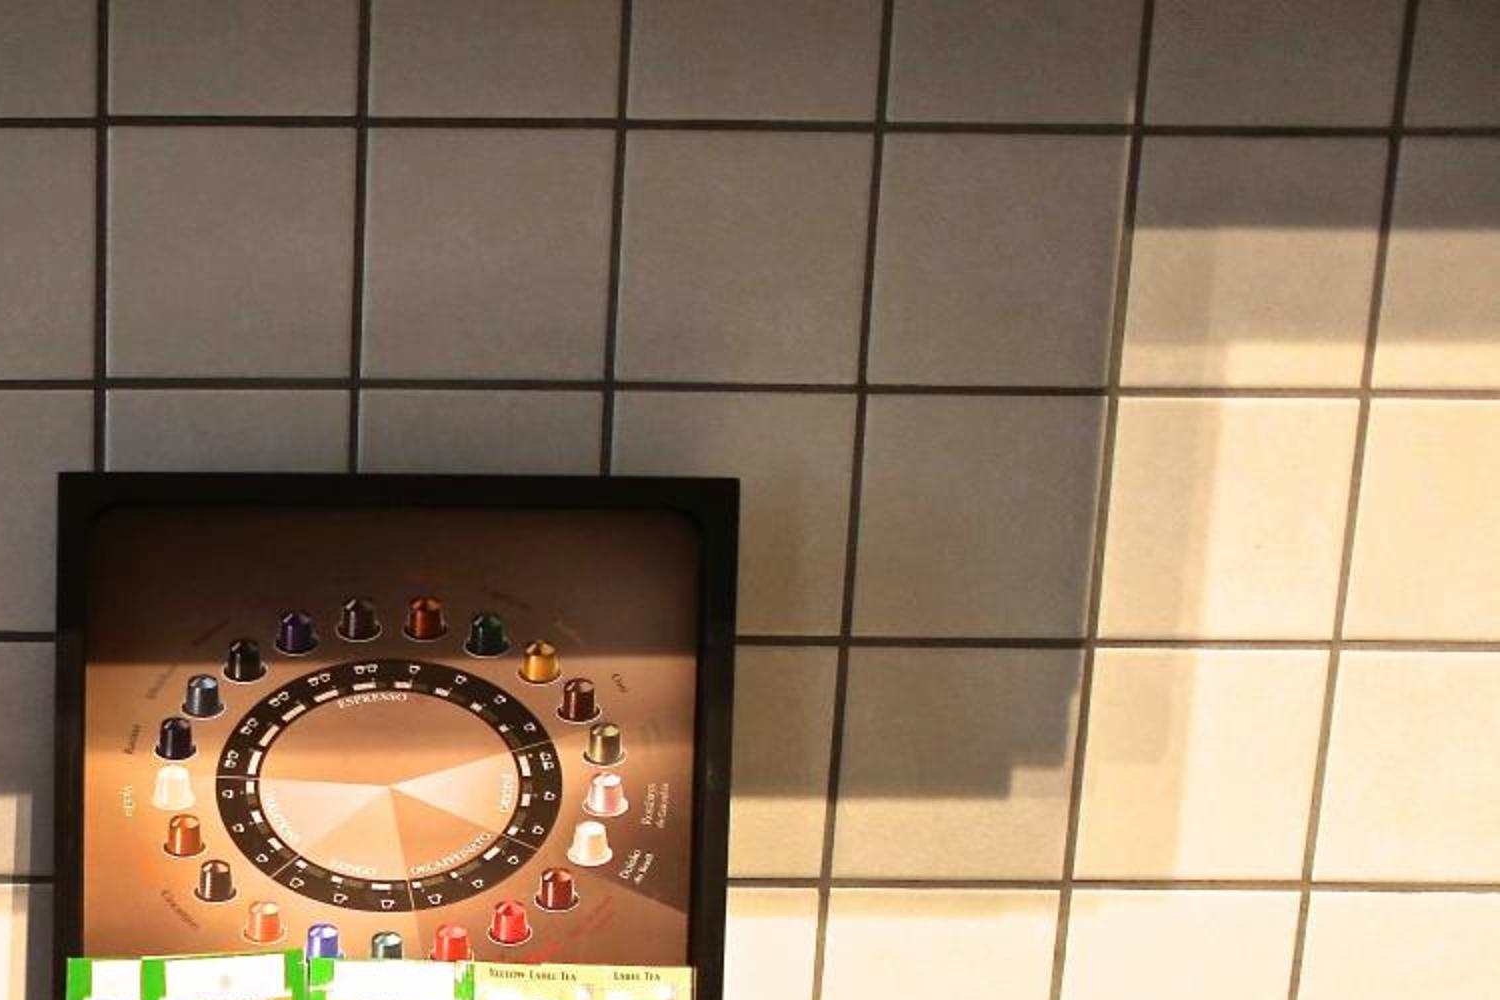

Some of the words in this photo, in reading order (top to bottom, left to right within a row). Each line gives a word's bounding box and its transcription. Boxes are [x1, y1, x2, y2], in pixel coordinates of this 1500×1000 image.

[489, 967, 525, 979] YELLOW
[529, 969, 557, 981] LABEL
[613, 971, 640, 982] LABEL
